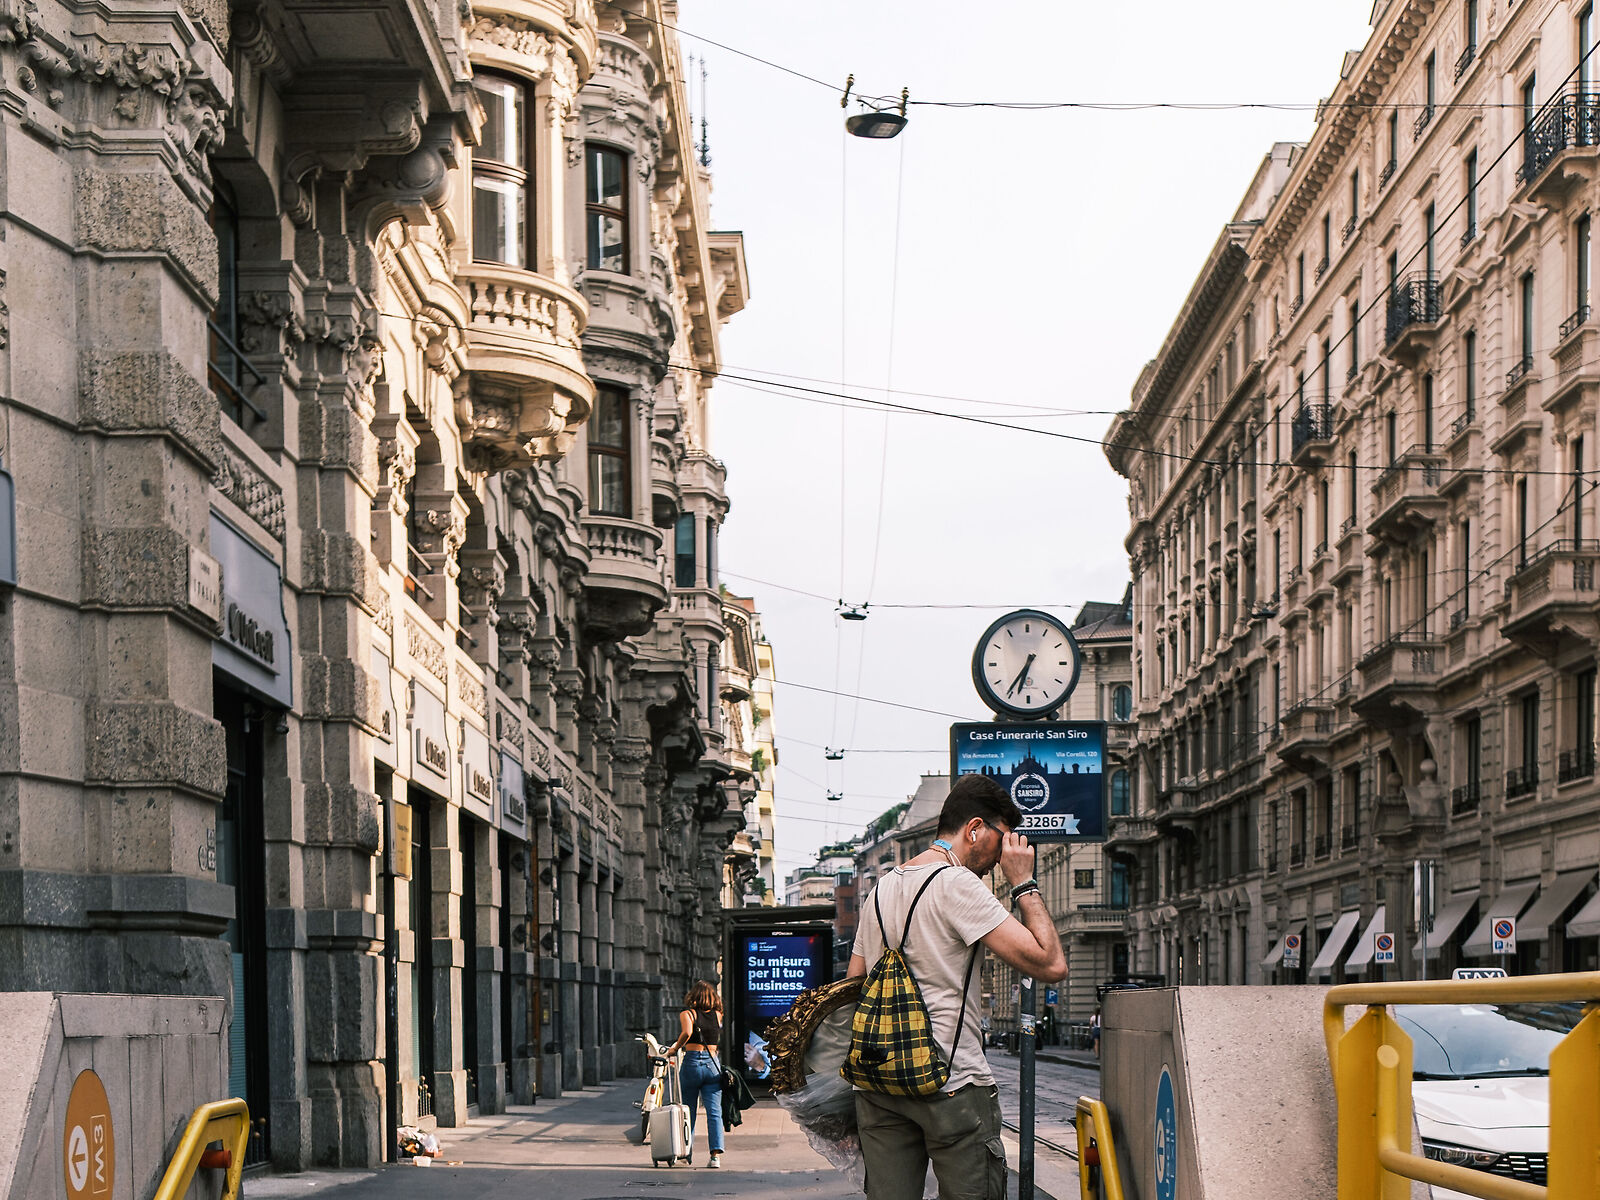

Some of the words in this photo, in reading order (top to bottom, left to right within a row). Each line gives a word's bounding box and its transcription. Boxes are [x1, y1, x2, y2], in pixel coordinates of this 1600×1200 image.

[193, 579, 216, 605] ITALIA
[969, 731, 994, 740] Case
[996, 730, 1045, 740] Funerarie
[1046, 730, 1066, 739] San
[1067, 730, 1088, 739] Siro
[1017, 789, 1044, 797] SANSIRO
[748, 956, 765, 967] Su
[768, 955, 811, 967] misura
[748, 970, 769, 980] per
[772, 967, 780, 978] il
[782, 967, 805, 978] tuo
[748, 980, 806, 991] business.
[94, 1123, 105, 1183] M3
